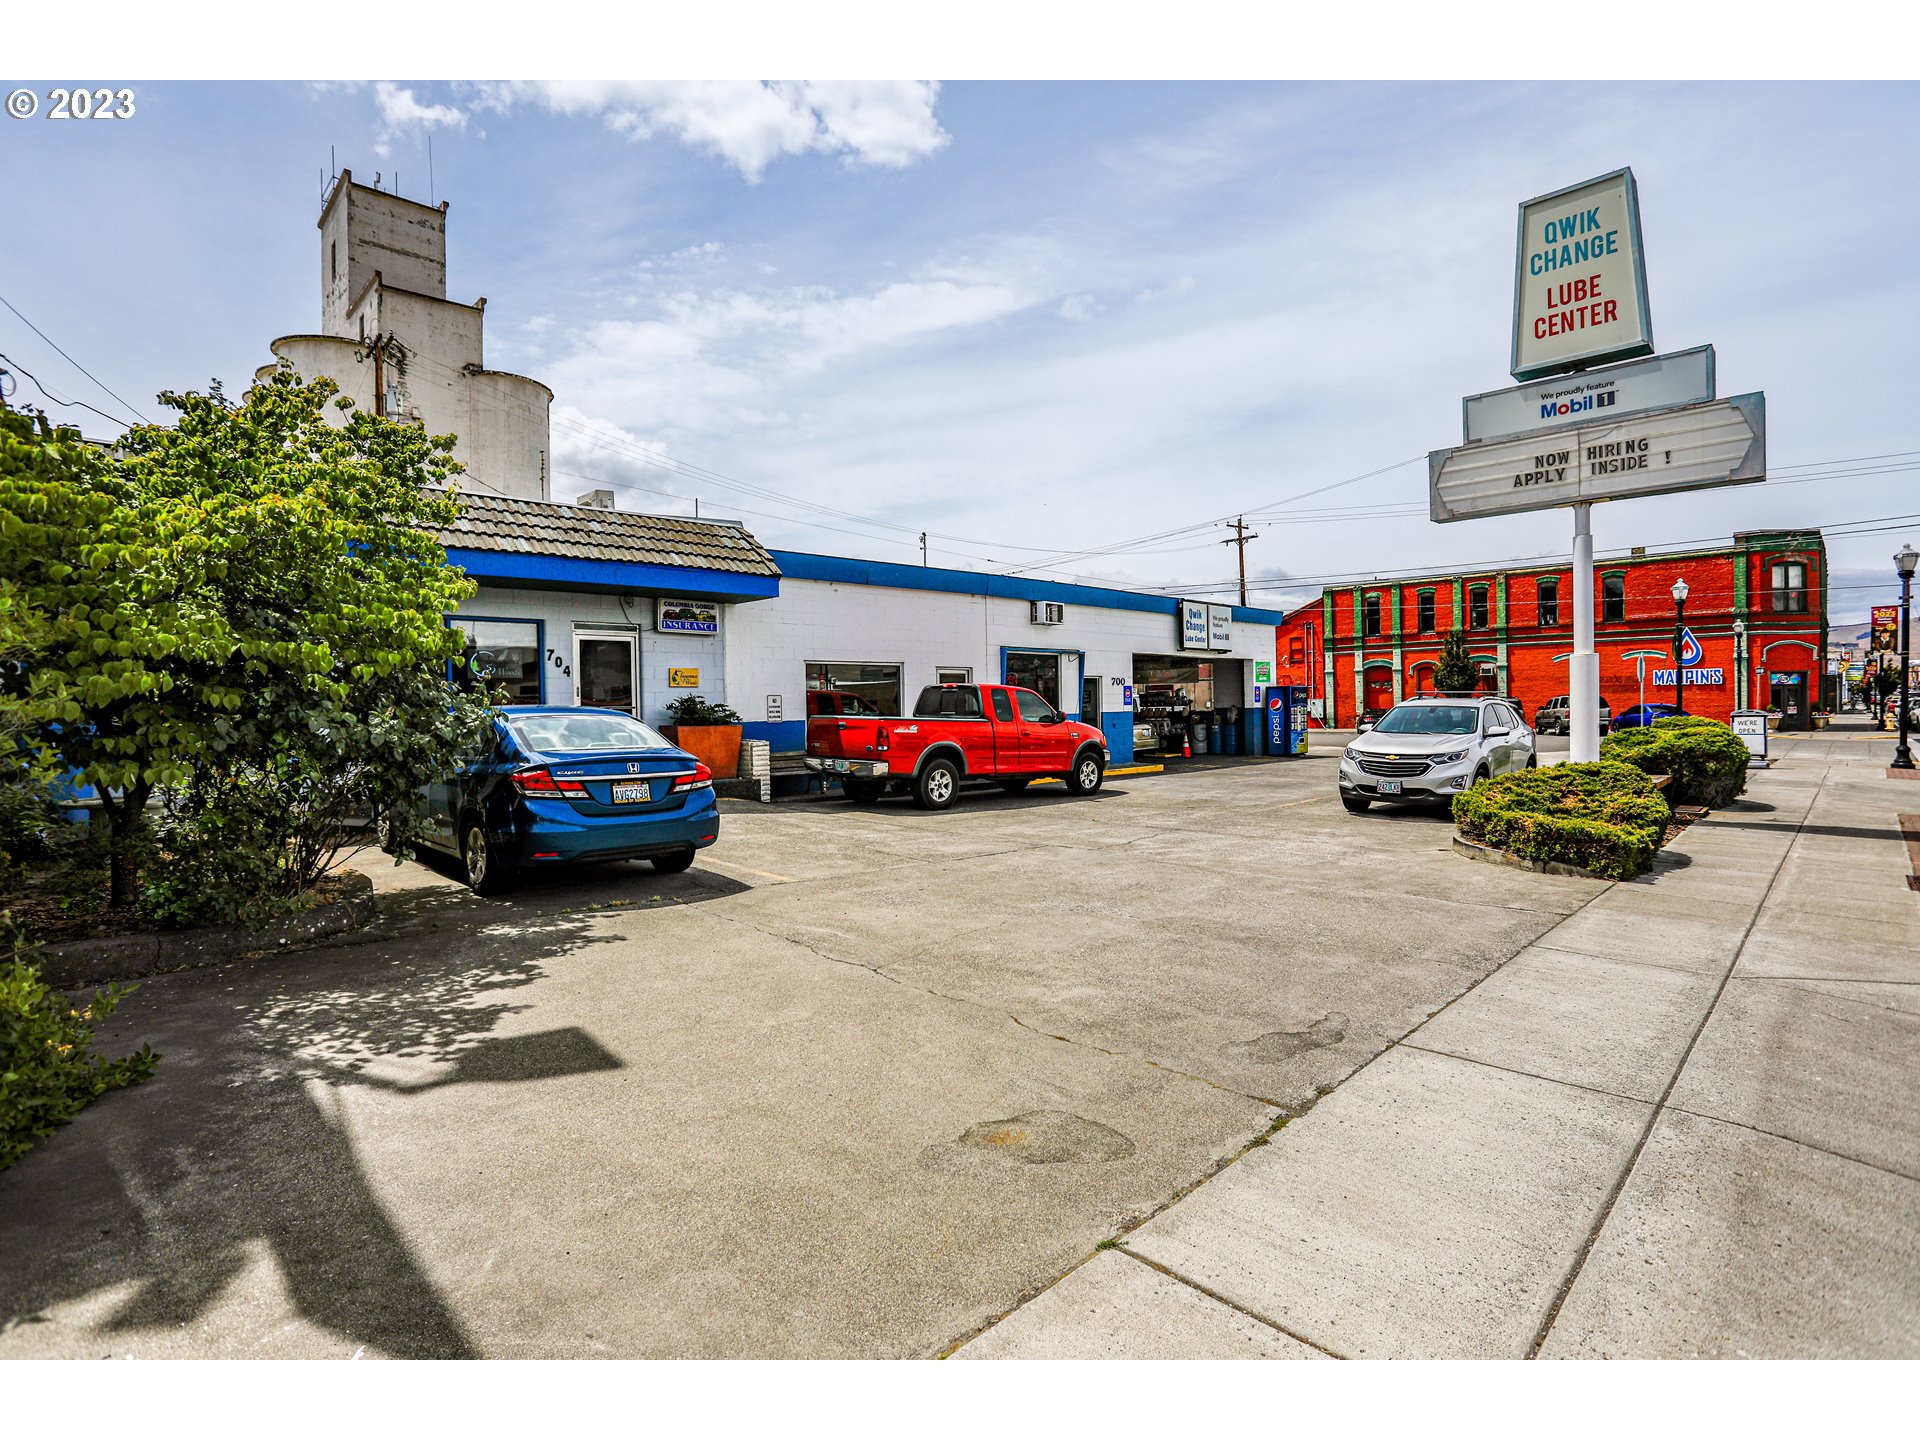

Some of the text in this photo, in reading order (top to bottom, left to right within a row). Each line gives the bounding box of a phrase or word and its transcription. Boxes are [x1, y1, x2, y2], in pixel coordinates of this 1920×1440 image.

[1544, 206, 1601, 245] QWIK
[1530, 230, 1619, 276] CHANGE
[1547, 274, 1602, 309] LUBE
[1534, 299, 1618, 340] CENTER
[1540, 380, 1615, 401] We proudly feature
[1541, 395, 1593, 419] Mobil
[1535, 438, 1649, 469] NOW HIRING
[1513, 467, 1566, 488] APPLY
[1592, 455, 1648, 475] INSIDE
[663, 600, 715, 611] COLUMBIA GORGE
[1188, 607, 1203, 620] Qwik
[662, 620, 717, 632] INSURANCE
[1185, 619, 1206, 633] Change
[546, 648, 572, 678] 704
[1111, 677, 1126, 686] 700
[1272, 714, 1282, 744] pepsi
